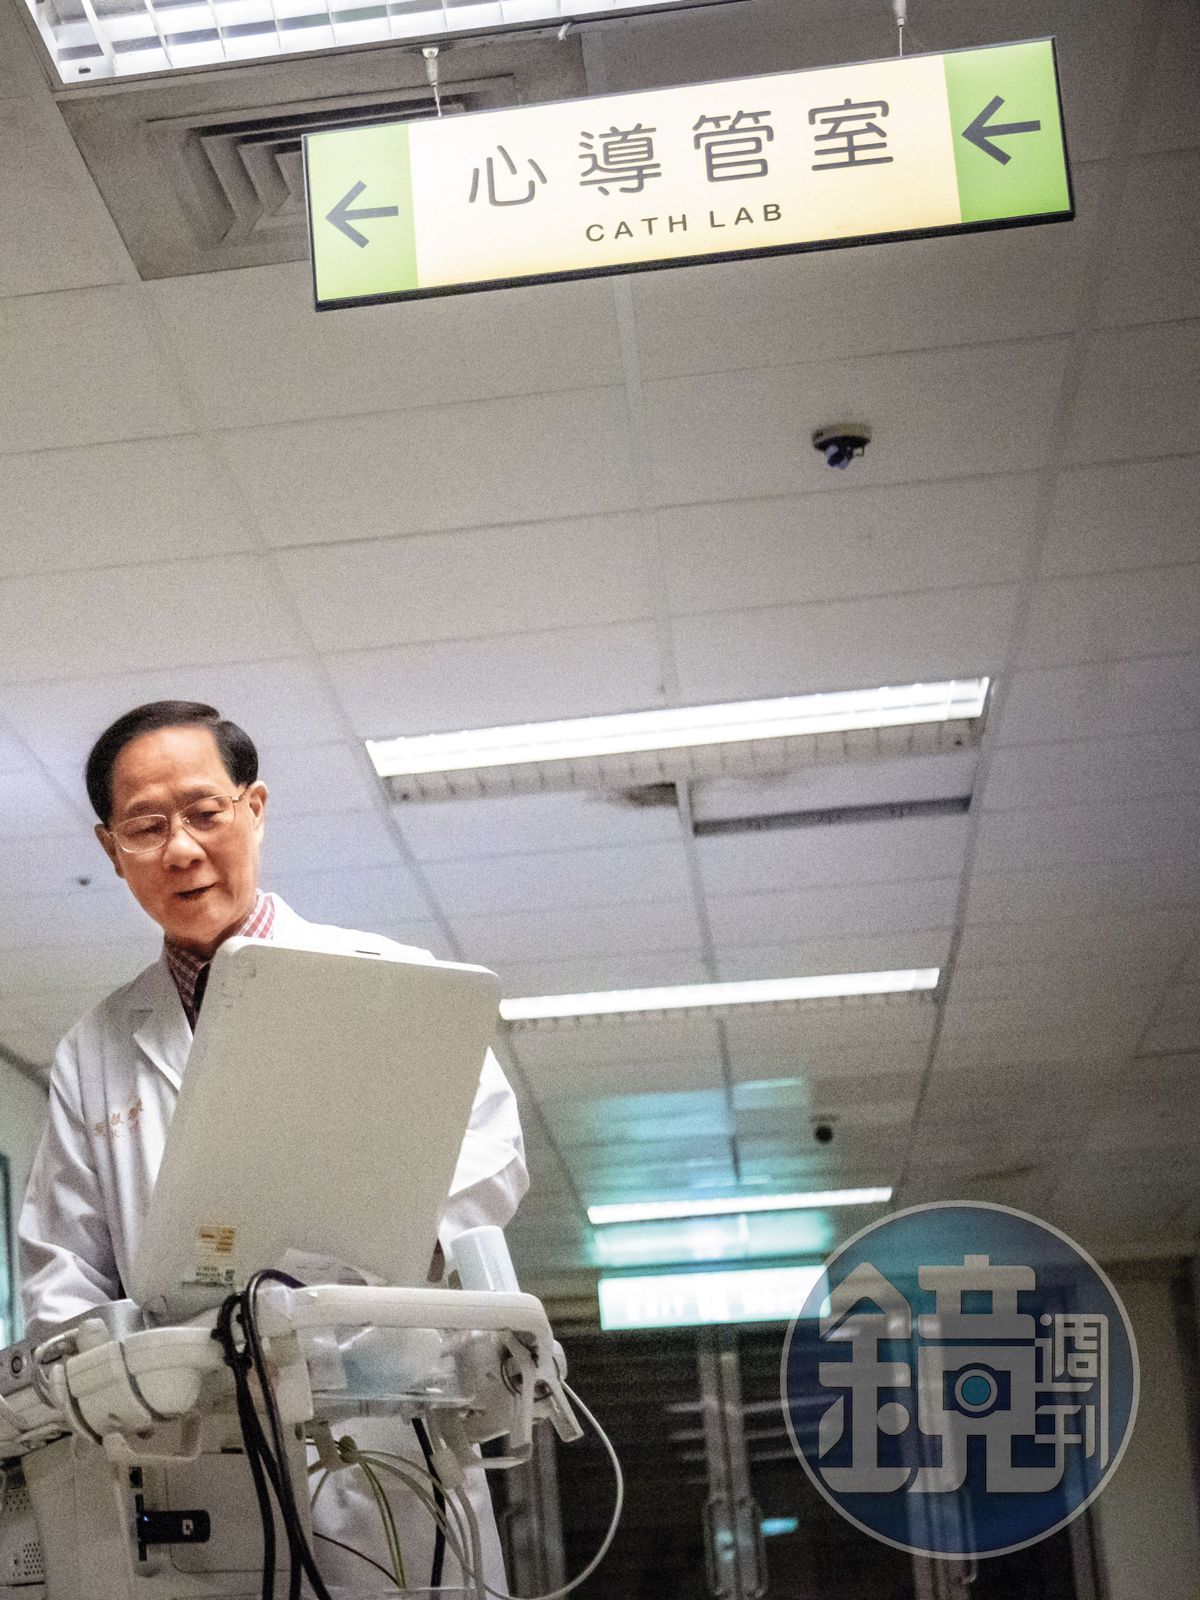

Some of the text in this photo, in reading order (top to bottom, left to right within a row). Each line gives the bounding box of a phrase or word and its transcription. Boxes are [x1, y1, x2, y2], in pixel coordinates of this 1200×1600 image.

[469, 98, 894, 207] 心導管室
[585, 203, 782, 242] CATH LAB
